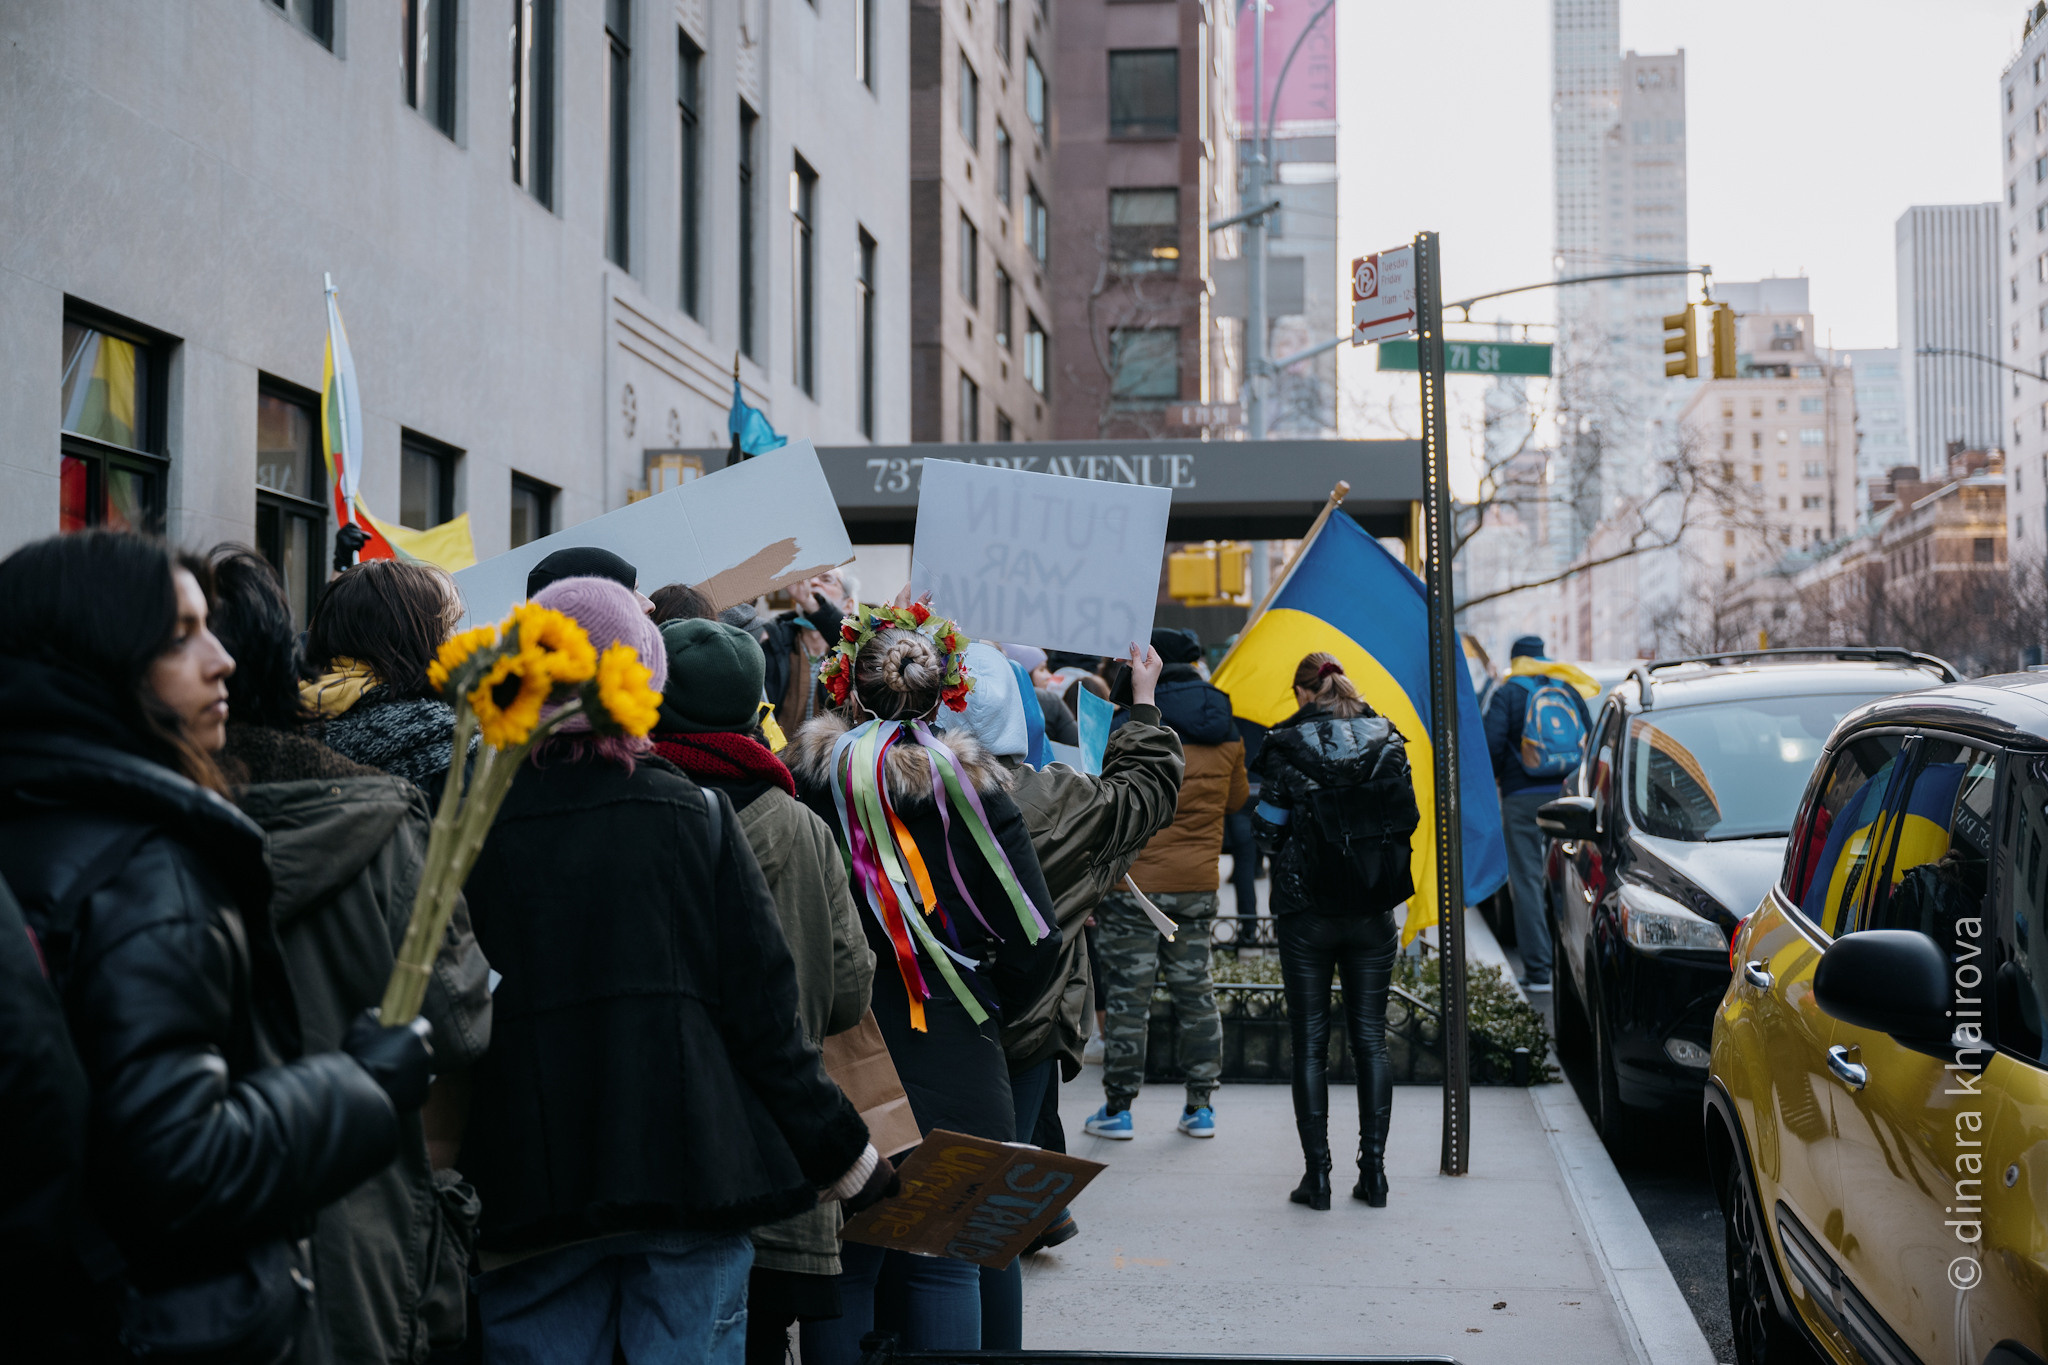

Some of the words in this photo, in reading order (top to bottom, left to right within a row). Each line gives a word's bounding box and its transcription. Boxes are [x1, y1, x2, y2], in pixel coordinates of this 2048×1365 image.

[1381, 258, 1408, 272] Tuesday
[1381, 274, 1402, 286] Friday
[1449, 345, 1470, 369] 71
[1477, 346, 1500, 370] St
[945, 1163, 1074, 1260] STAND
